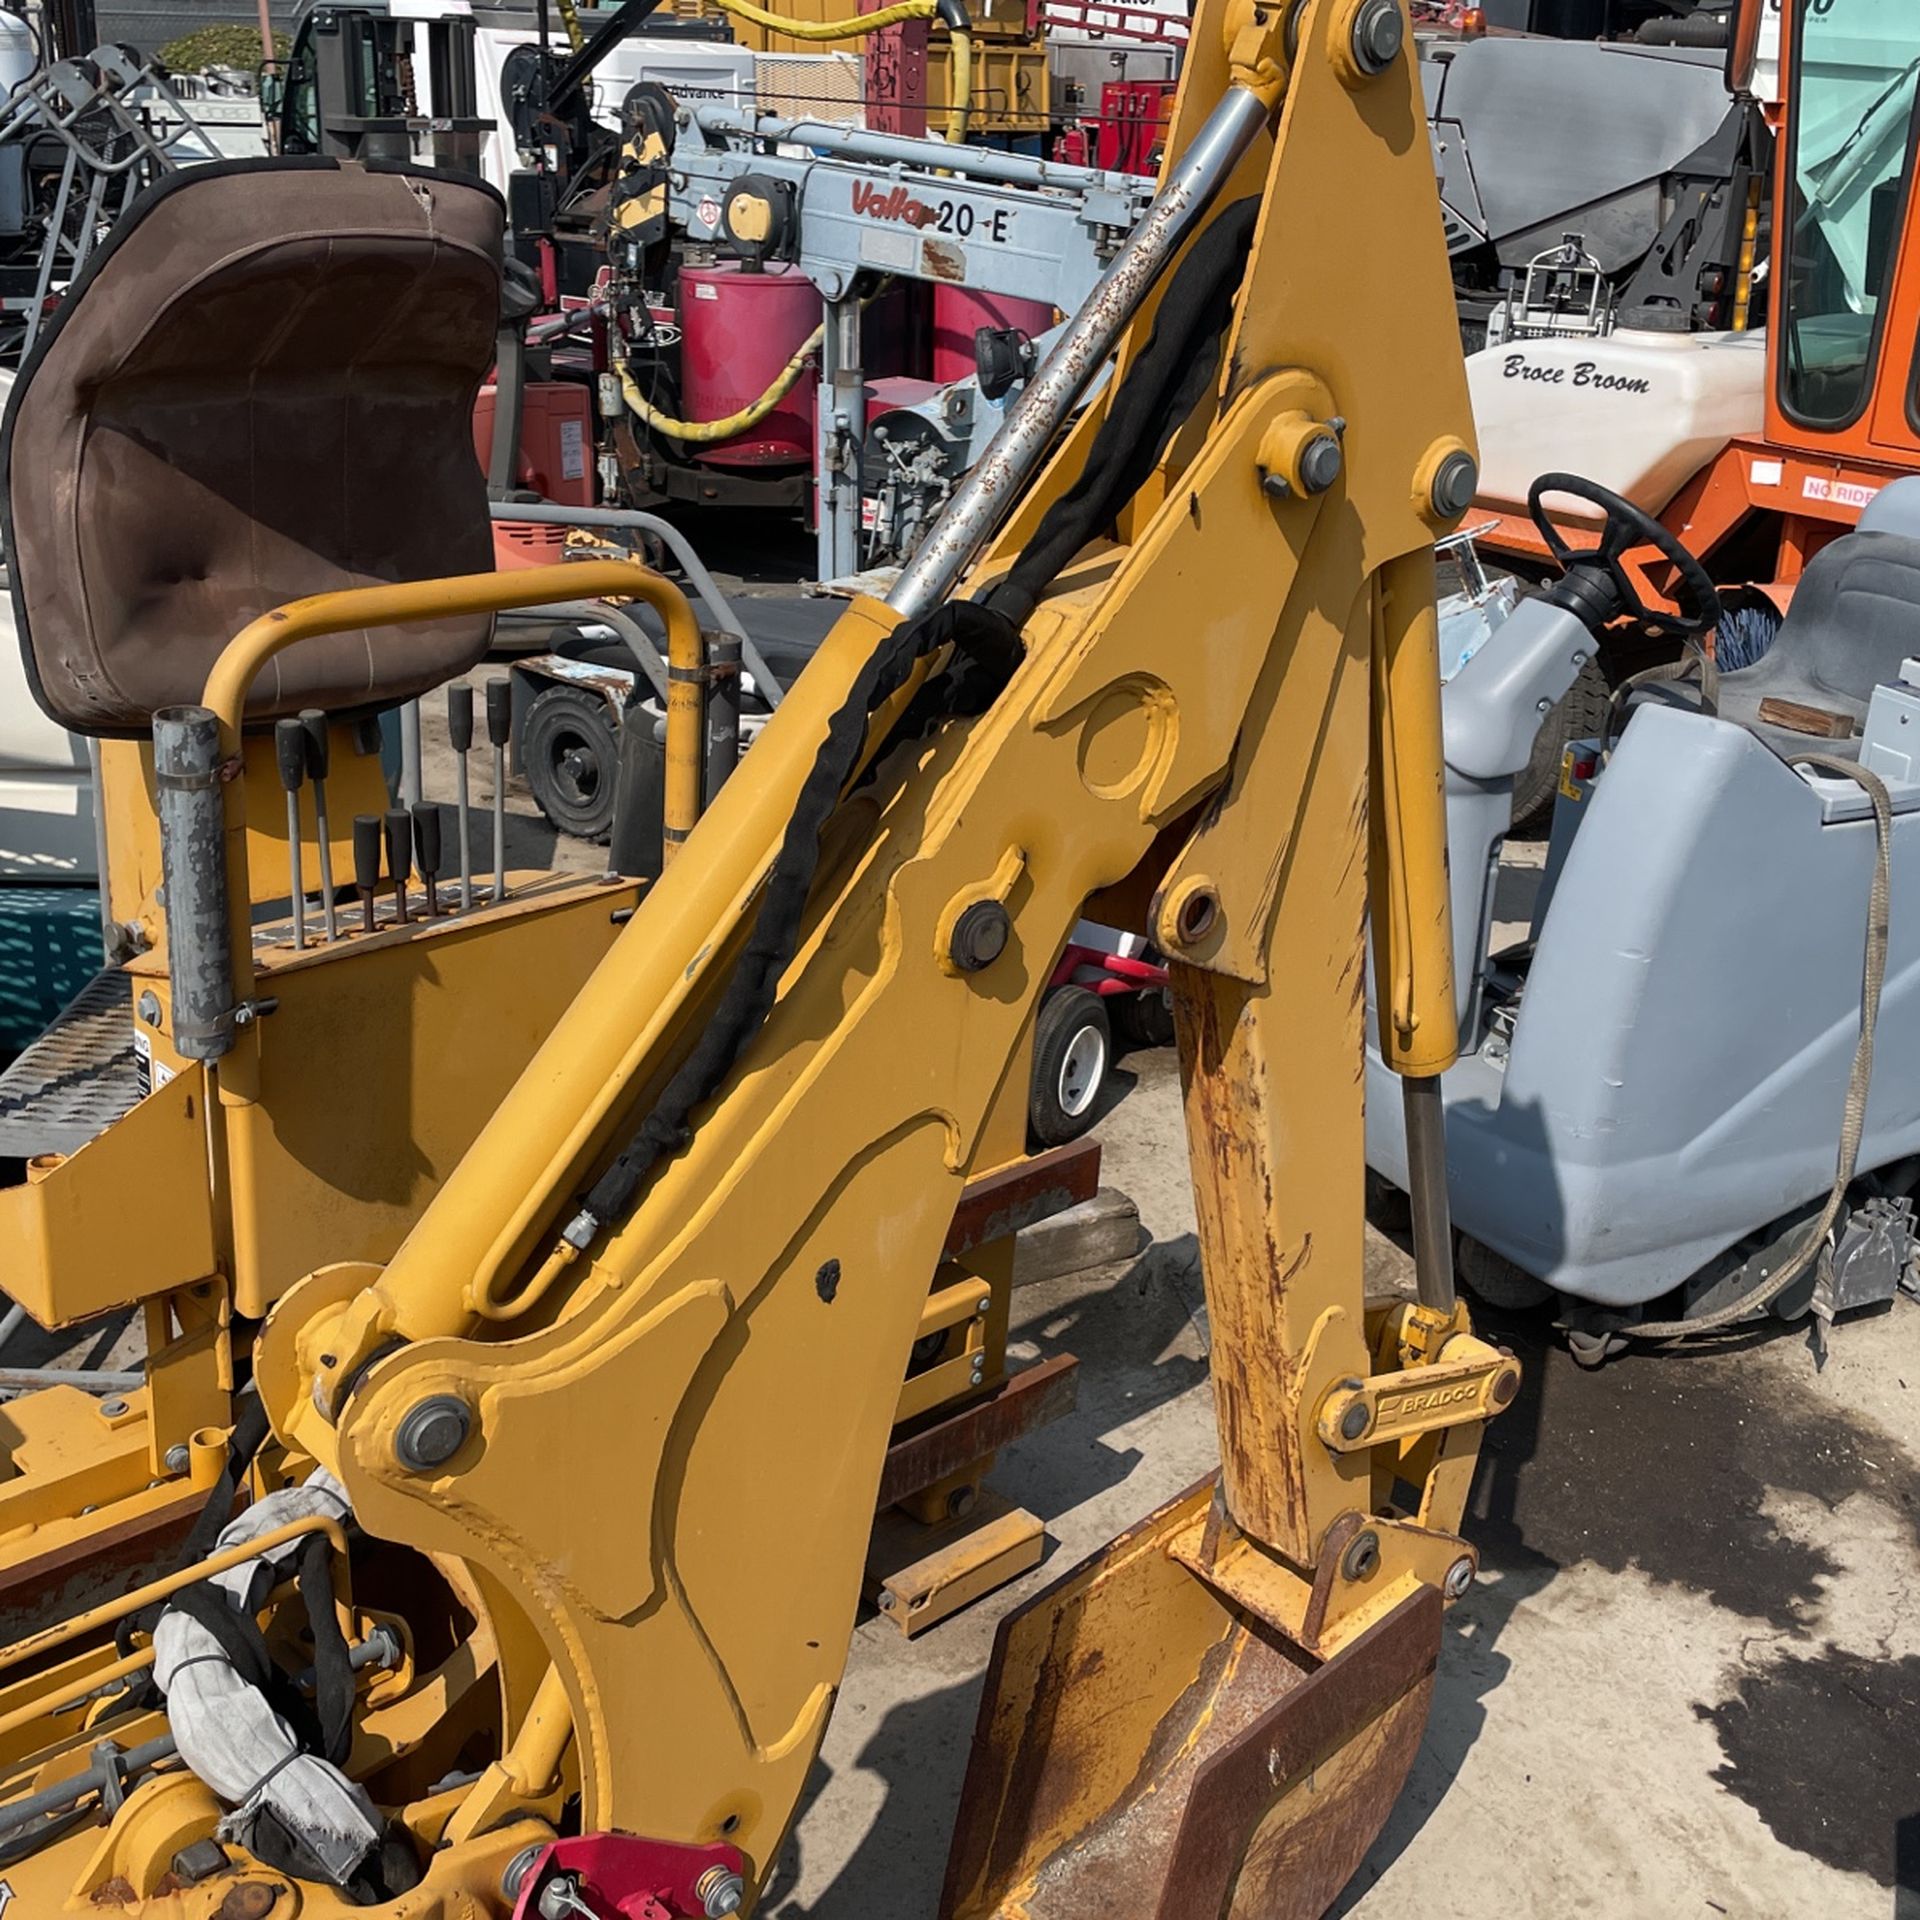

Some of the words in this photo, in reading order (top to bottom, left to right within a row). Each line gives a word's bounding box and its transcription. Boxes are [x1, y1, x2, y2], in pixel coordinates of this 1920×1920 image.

[671, 84, 725, 99] Advance
[937, 200, 974, 236] 20
[1503, 354, 1564, 383] Broce
[1572, 362, 1650, 393] Broom
[1808, 482, 1832, 497] NO
[1402, 1384, 1477, 1415] BRADCO
